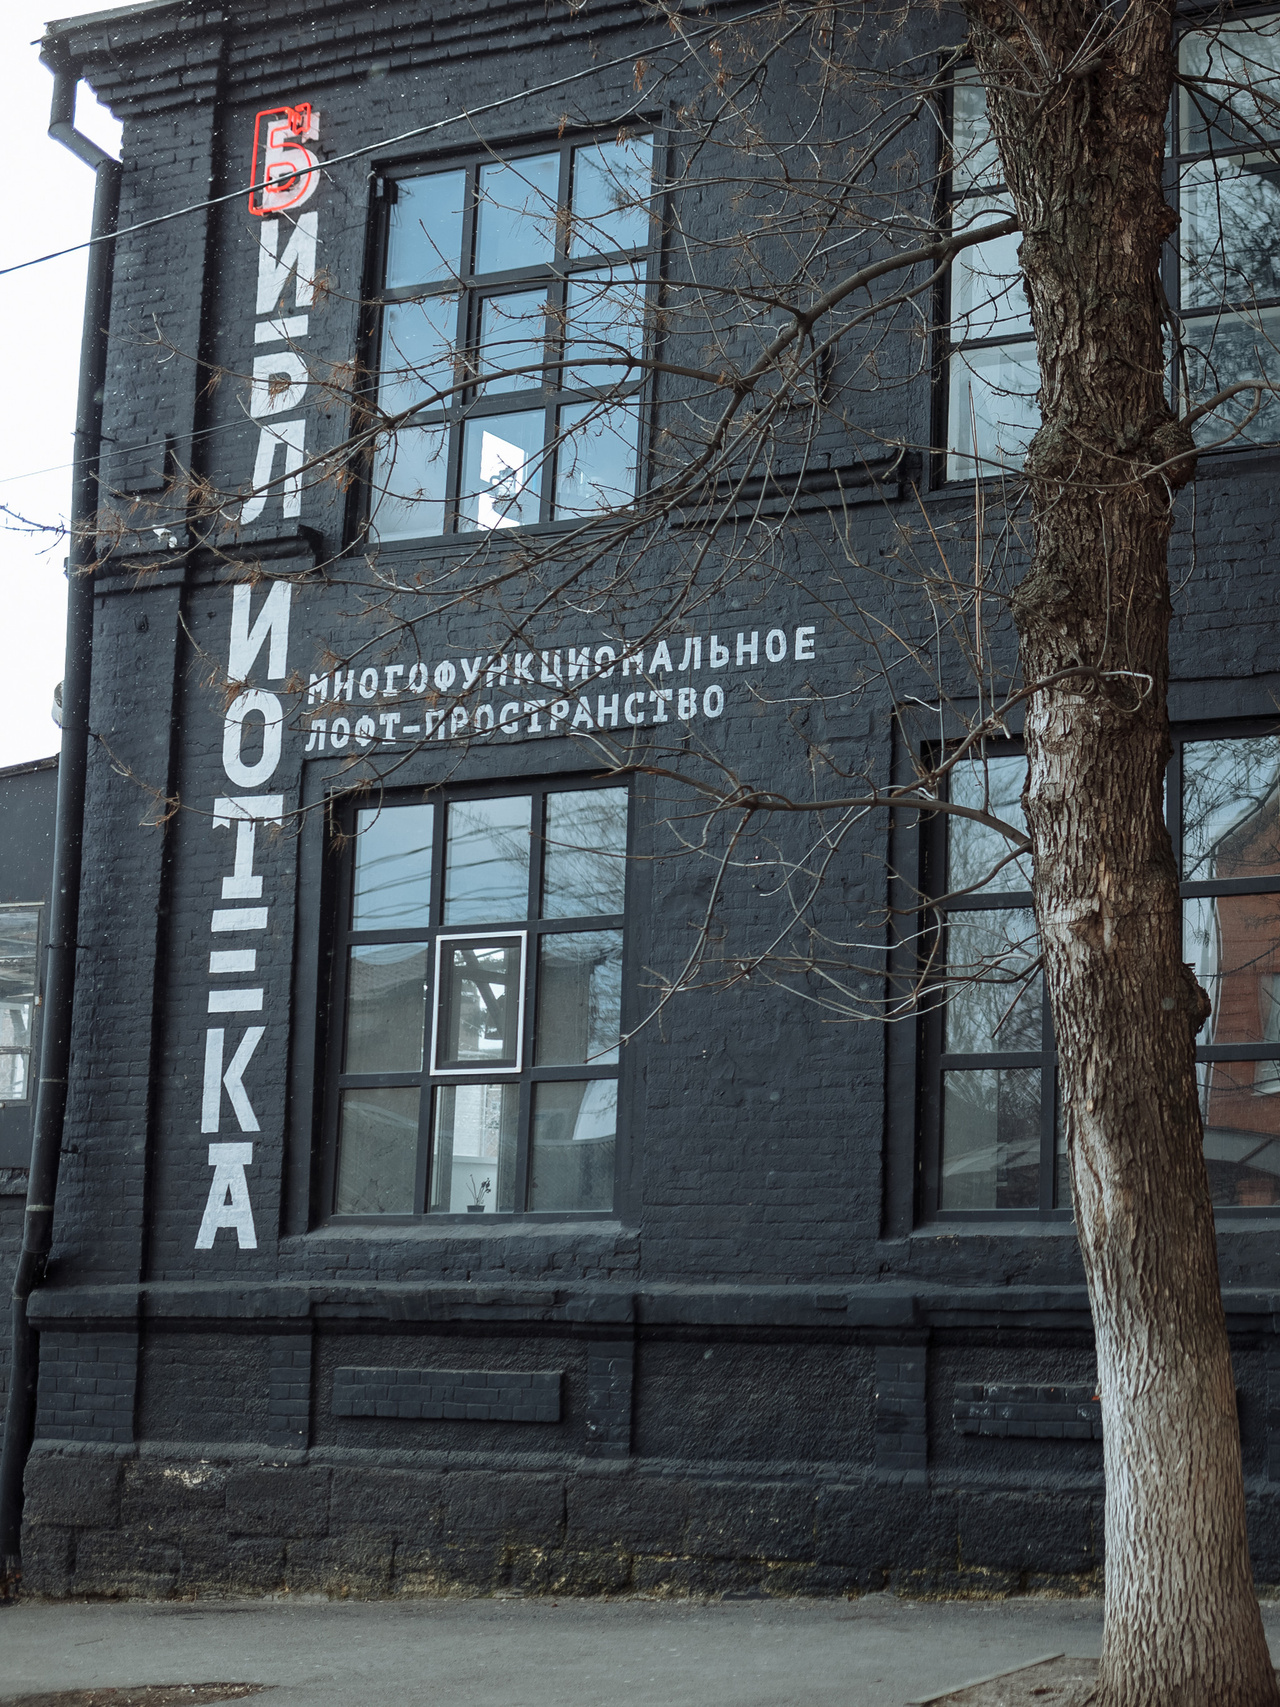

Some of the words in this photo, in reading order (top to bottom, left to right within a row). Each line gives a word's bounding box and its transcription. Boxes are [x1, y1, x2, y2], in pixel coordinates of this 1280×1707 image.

[194, 102, 321, 1250] БИБЛИОТЕКА
[307, 626, 816, 704] МНОГОФУНКЦИОНАЛЬНОЕ
[305, 684, 725, 752] ЛОФТ-ПРОСТРАНСТВО
